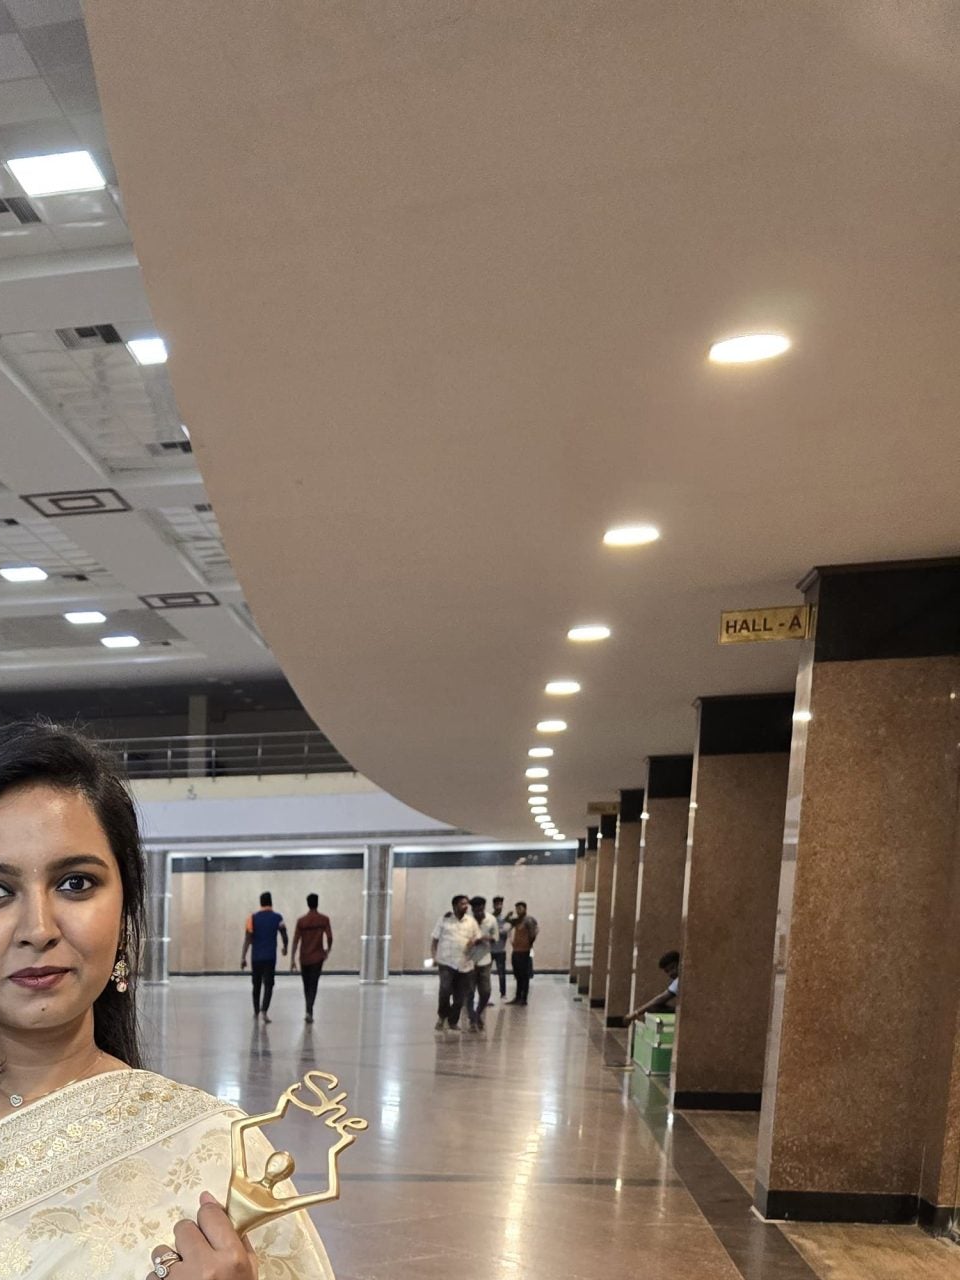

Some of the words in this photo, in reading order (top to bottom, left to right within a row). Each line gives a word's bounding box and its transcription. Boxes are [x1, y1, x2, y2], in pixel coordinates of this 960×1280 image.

[726, 617, 773, 634] HALL
[788, 614, 802, 631] A
[289, 1070, 369, 1136] She
